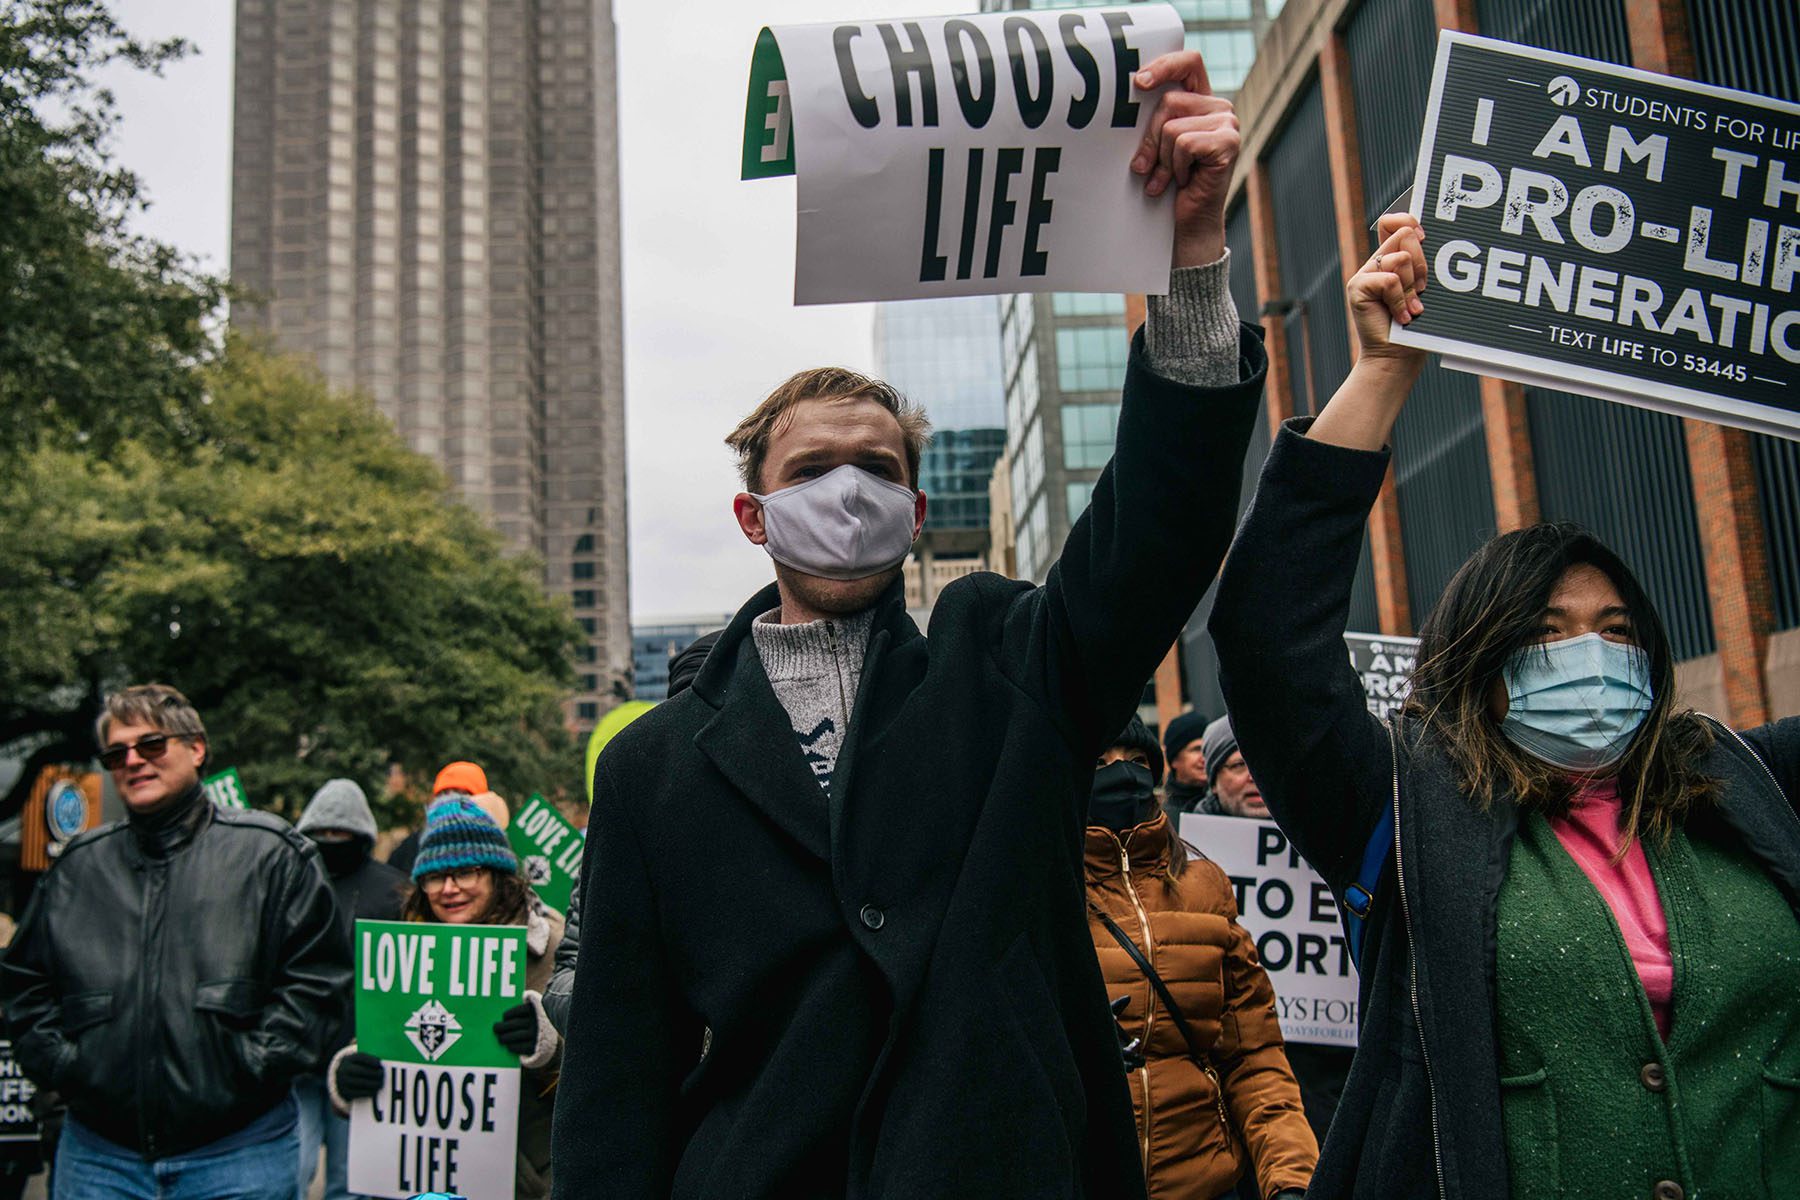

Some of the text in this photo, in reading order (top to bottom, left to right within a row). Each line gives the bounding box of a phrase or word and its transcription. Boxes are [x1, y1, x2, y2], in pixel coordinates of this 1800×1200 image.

[833, 12, 1141, 130] CHOOSE
[1471, 97, 1494, 146] I
[1532, 115, 1669, 183] AM
[1585, 88, 1708, 130] STUDENTS
[1714, 115, 1765, 143] FOR
[919, 147, 1062, 283] LIFE
[1549, 325, 1748, 383] TEXT LIFE TO 53445
[1360, 672, 1413, 701] RO
[516, 799, 570, 856] LOVE
[1227, 875, 1294, 920] TO
[362, 931, 519, 998] LOVE LIFE
[399, 1133, 460, 1195] LIFE
